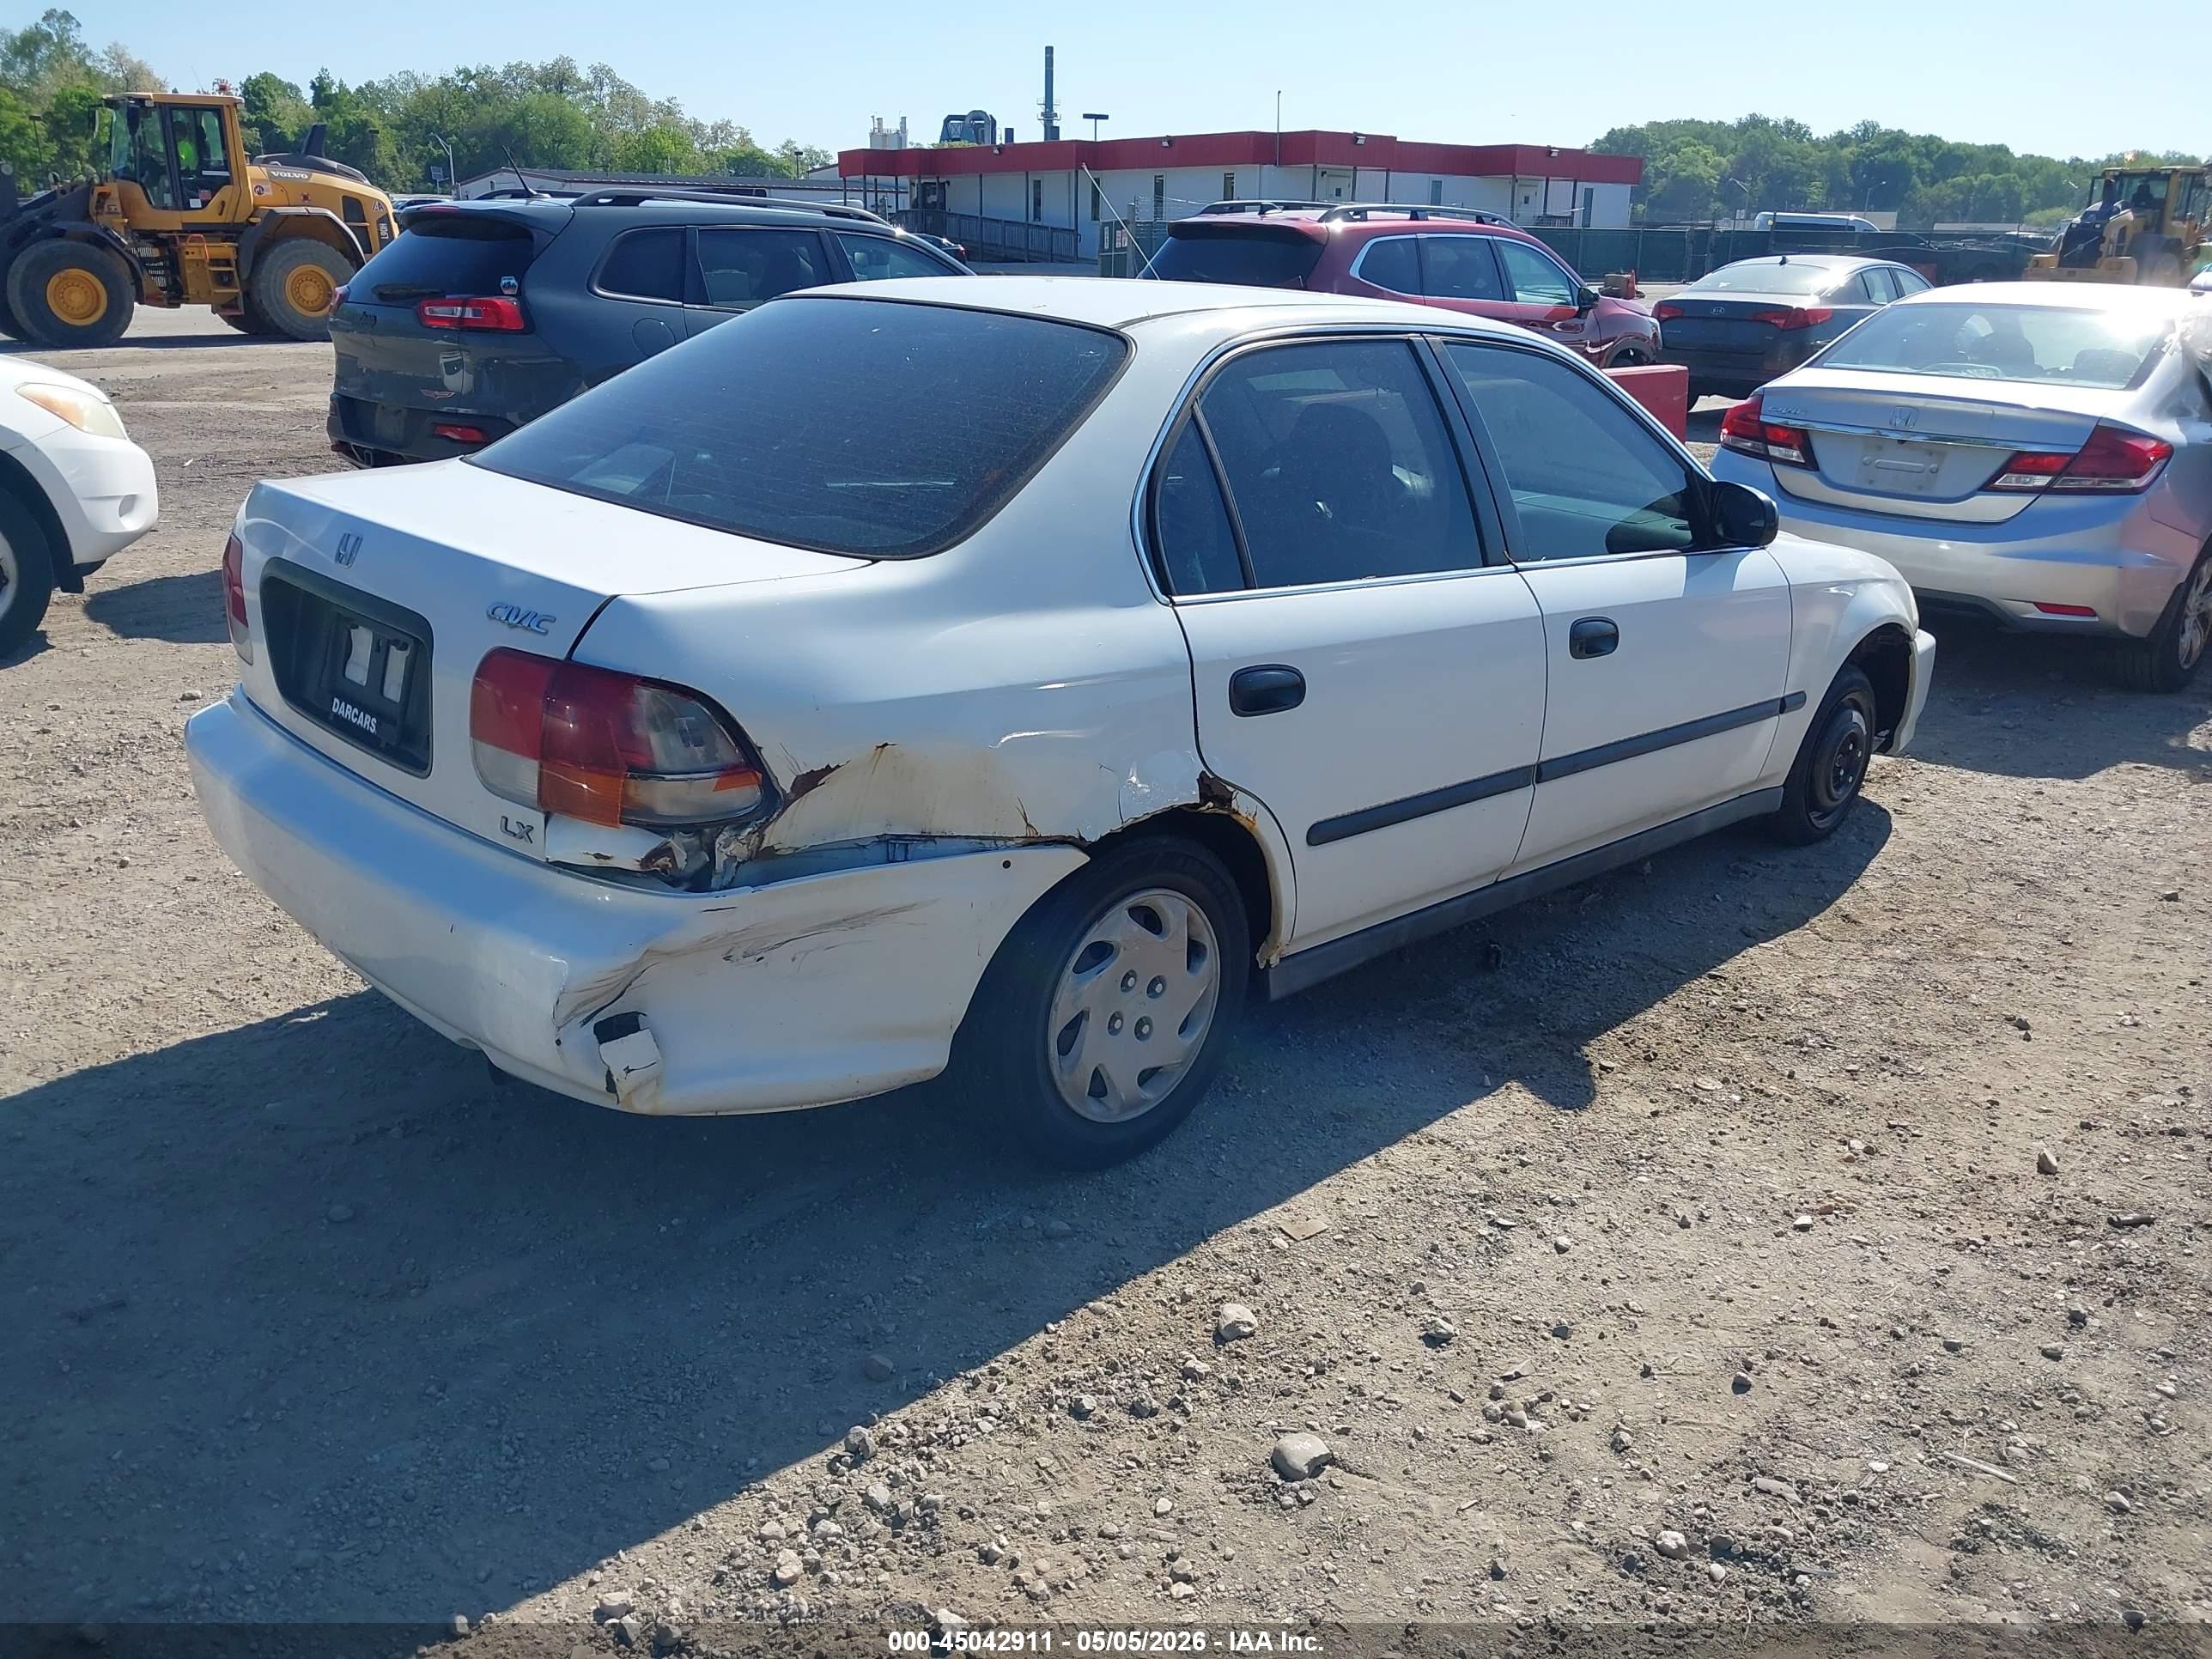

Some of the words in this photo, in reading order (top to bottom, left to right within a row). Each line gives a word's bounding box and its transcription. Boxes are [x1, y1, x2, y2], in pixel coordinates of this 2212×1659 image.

[270, 171, 308, 179] VOLVO
[379, 222, 389, 240] L90H
[486, 603, 556, 635] CIVIC
[331, 697, 377, 734] DARCARS
[499, 816, 534, 844] LX
